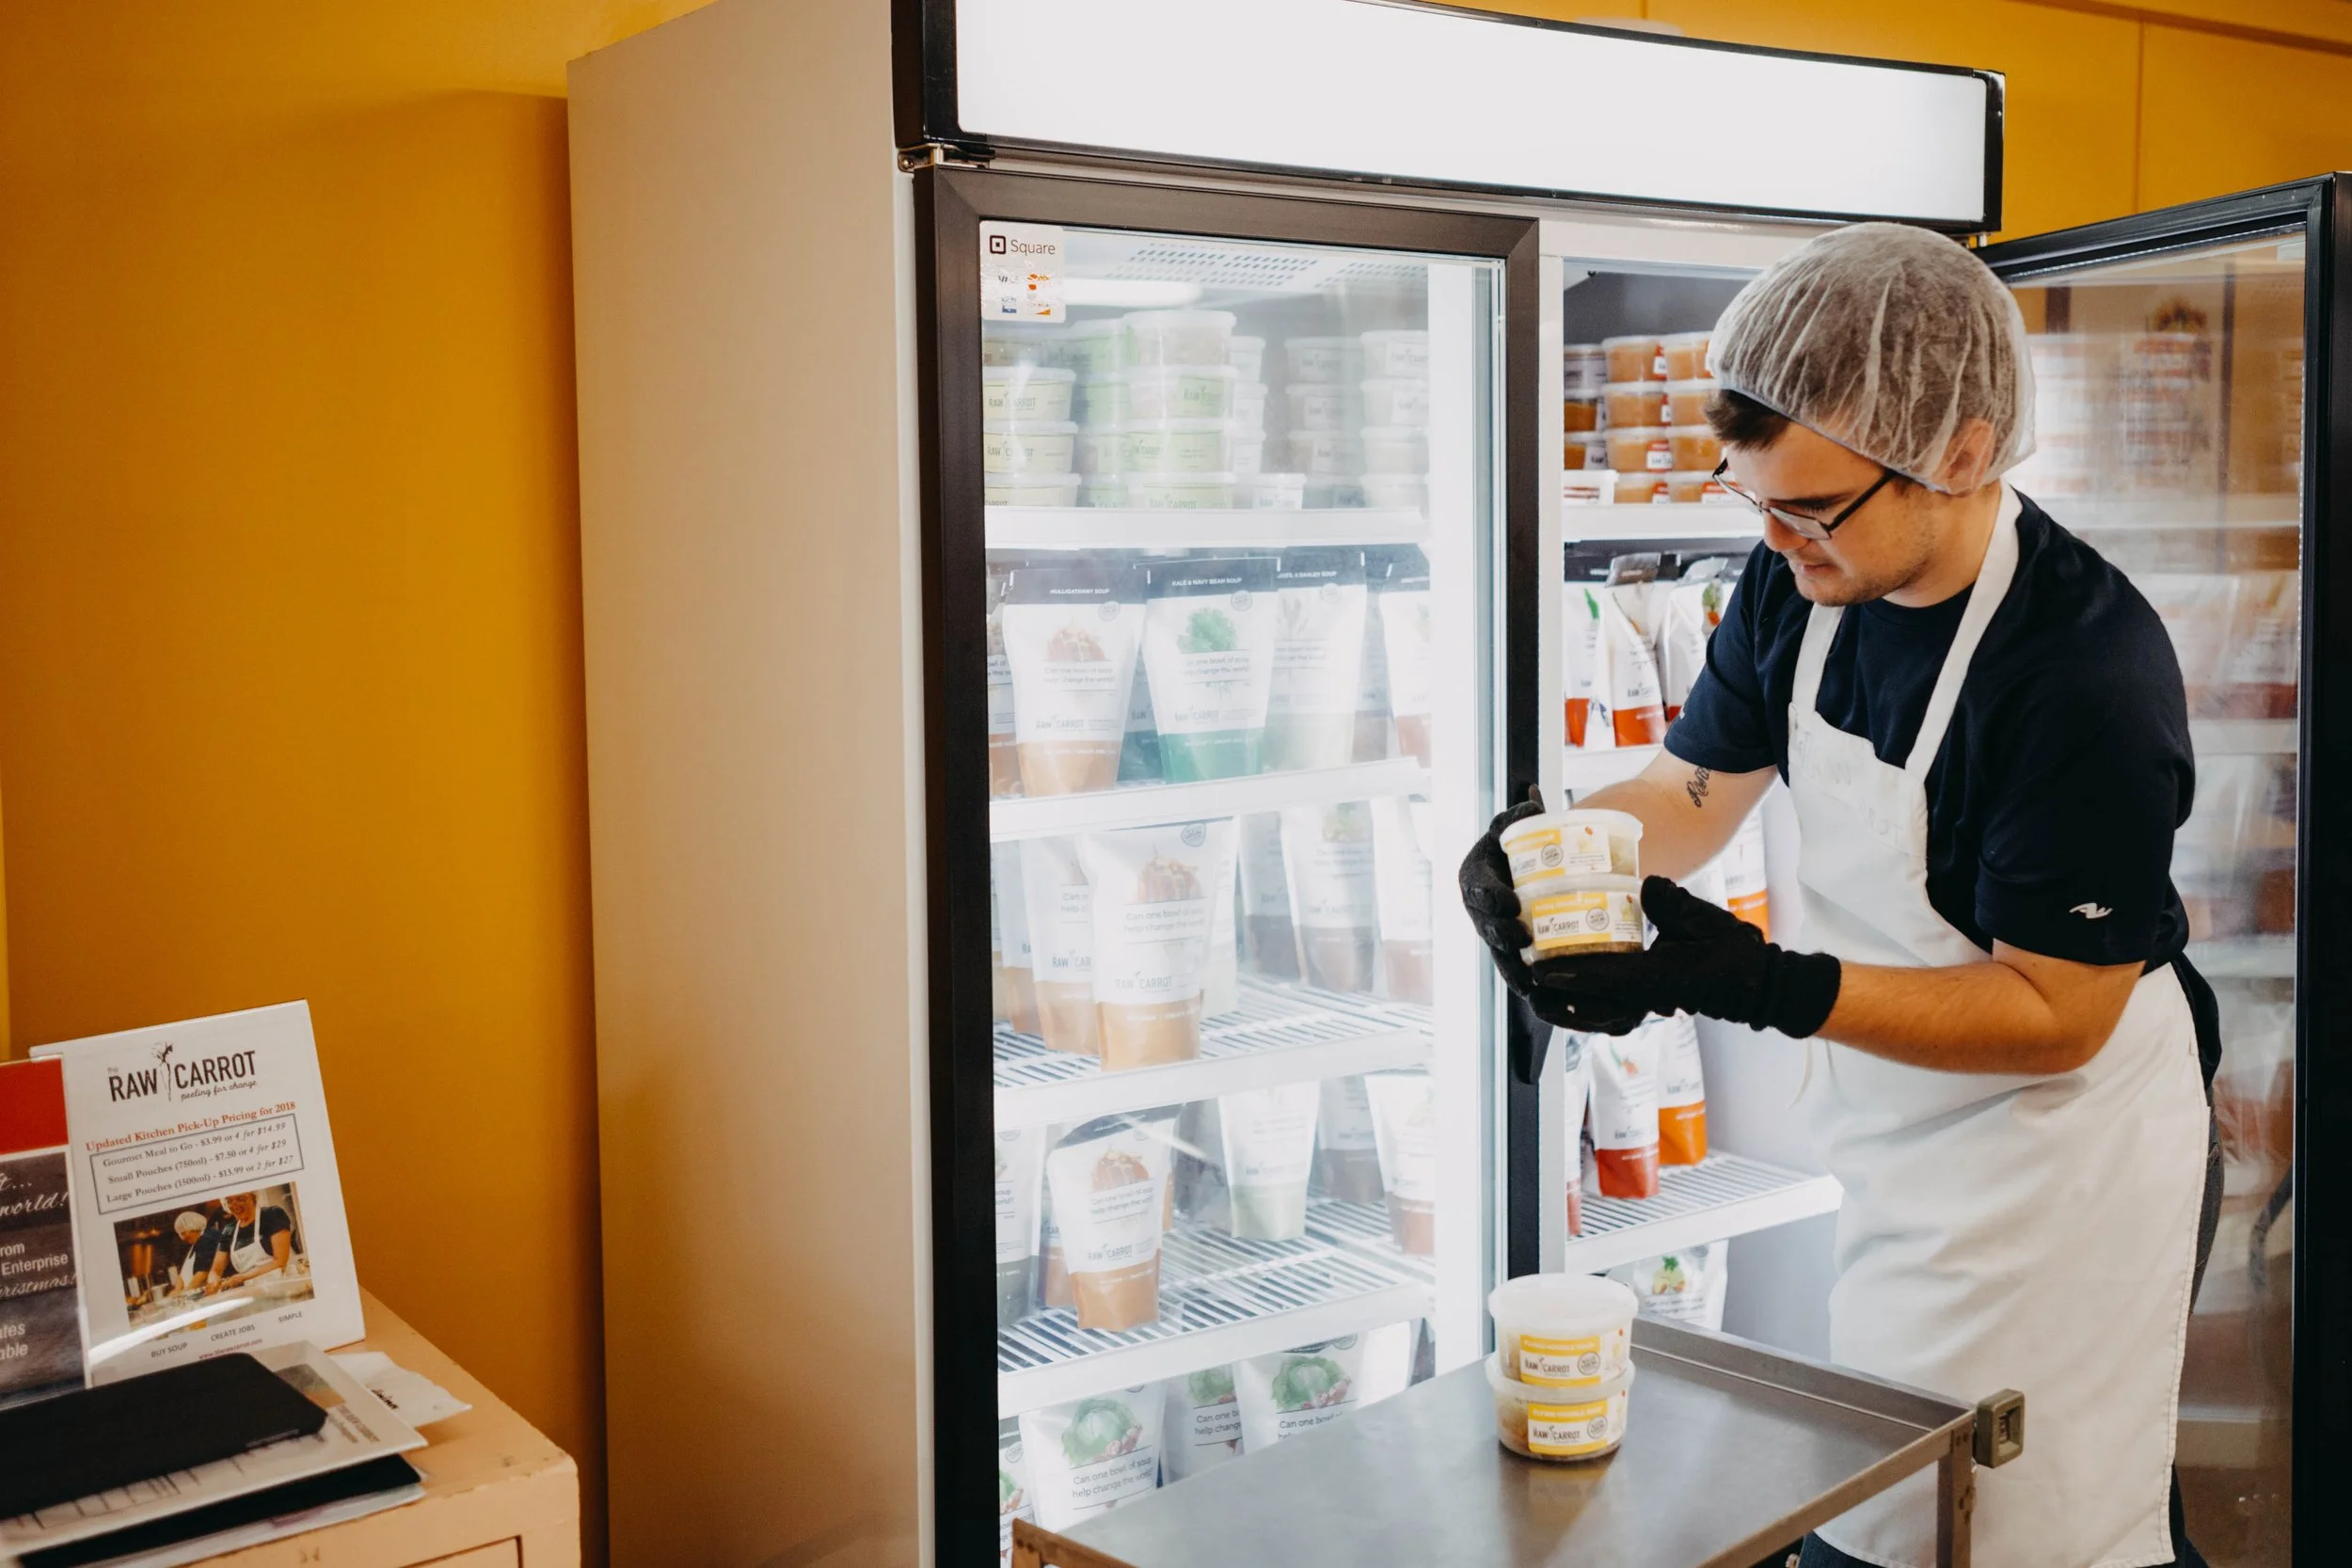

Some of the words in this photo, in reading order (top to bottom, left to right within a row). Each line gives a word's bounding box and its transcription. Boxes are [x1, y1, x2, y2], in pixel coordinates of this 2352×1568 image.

[1009, 239, 1057, 256] Square
[988, 398, 1004, 407] RAW
[1125, 911, 1145, 920] Can
[1146, 910, 1162, 919] one
[1052, 956, 1069, 969] RAW
[1074, 956, 1091, 968] CAR
[1139, 975, 1172, 990] CARROT
[108, 1069, 157, 1101] RAW
[174, 1051, 255, 1089] CARROT
[181, 1088, 211, 1101] peeling
[213, 1085, 227, 1096] for
[230, 1081, 257, 1092] change
[85, 1134, 132, 1152] Updated
[135, 1126, 175, 1142] Kitchen
[177, 1118, 219, 1133] Pick-Up
[222, 1111, 258, 1124] Pricing
[260, 1106, 274, 1117] for
[275, 1101, 296, 1113] 2018
[103, 1153, 143, 1167] Gourmet
[145, 1147, 167, 1159] Meal
[169, 1145, 178, 1153] to
[180, 1142, 193, 1150] Go
[199, 1135, 222, 1148] $3.99
[242, 1128, 255, 1141] for
[107, 1172, 134, 1185] Small
[135, 1165, 173, 1180] Pouches
[175, 1156, 208, 1171] (750ml)
[215, 1149, 237, 1163] $7.50
[238, 1148, 247, 1156] or
[256, 1143, 269, 1156] for
[271, 1139, 287, 1150] $29
[106, 1191, 133, 1204] Large
[135, 1182, 173, 1196] Pouches
[246, 1164, 255, 1172] or
[263, 1159, 277, 1172] for
[278, 1155, 294, 1166] $27
[0, 1243, 25, 1258] rom
[1, 1253, 69, 1276] Enterprise
[0, 1273, 76, 1298] ristmas!
[278, 1309, 302, 1323] SIMPLE
[210, 1327, 238, 1342] CREATE
[237, 1323, 256, 1336] JOBS
[151, 1345, 168, 1358] BUY
[168, 1340, 188, 1354] SOUP
[1523, 1359, 1539, 1370] RAW
[1543, 1363, 1570, 1374] CARROT
[1196, 1414, 1213, 1424] Can
[1214, 1412, 1232, 1421] one
[1279, 1419, 1297, 1429] Can
[1298, 1418, 1314, 1428] one
[1194, 1426, 1214, 1436] help
[1533, 1428, 1548, 1439] RAW
[1552, 1430, 1581, 1441] CARROT
[1073, 1475, 1091, 1486] Can
[1091, 1471, 1108, 1481] one
[1110, 1465, 1127, 1477] bowl
[1128, 1461, 1136, 1470] of
[1073, 1488, 1091, 1499] help
[1092, 1481, 1121, 1496] change
[1122, 1476, 1135, 1486] the
